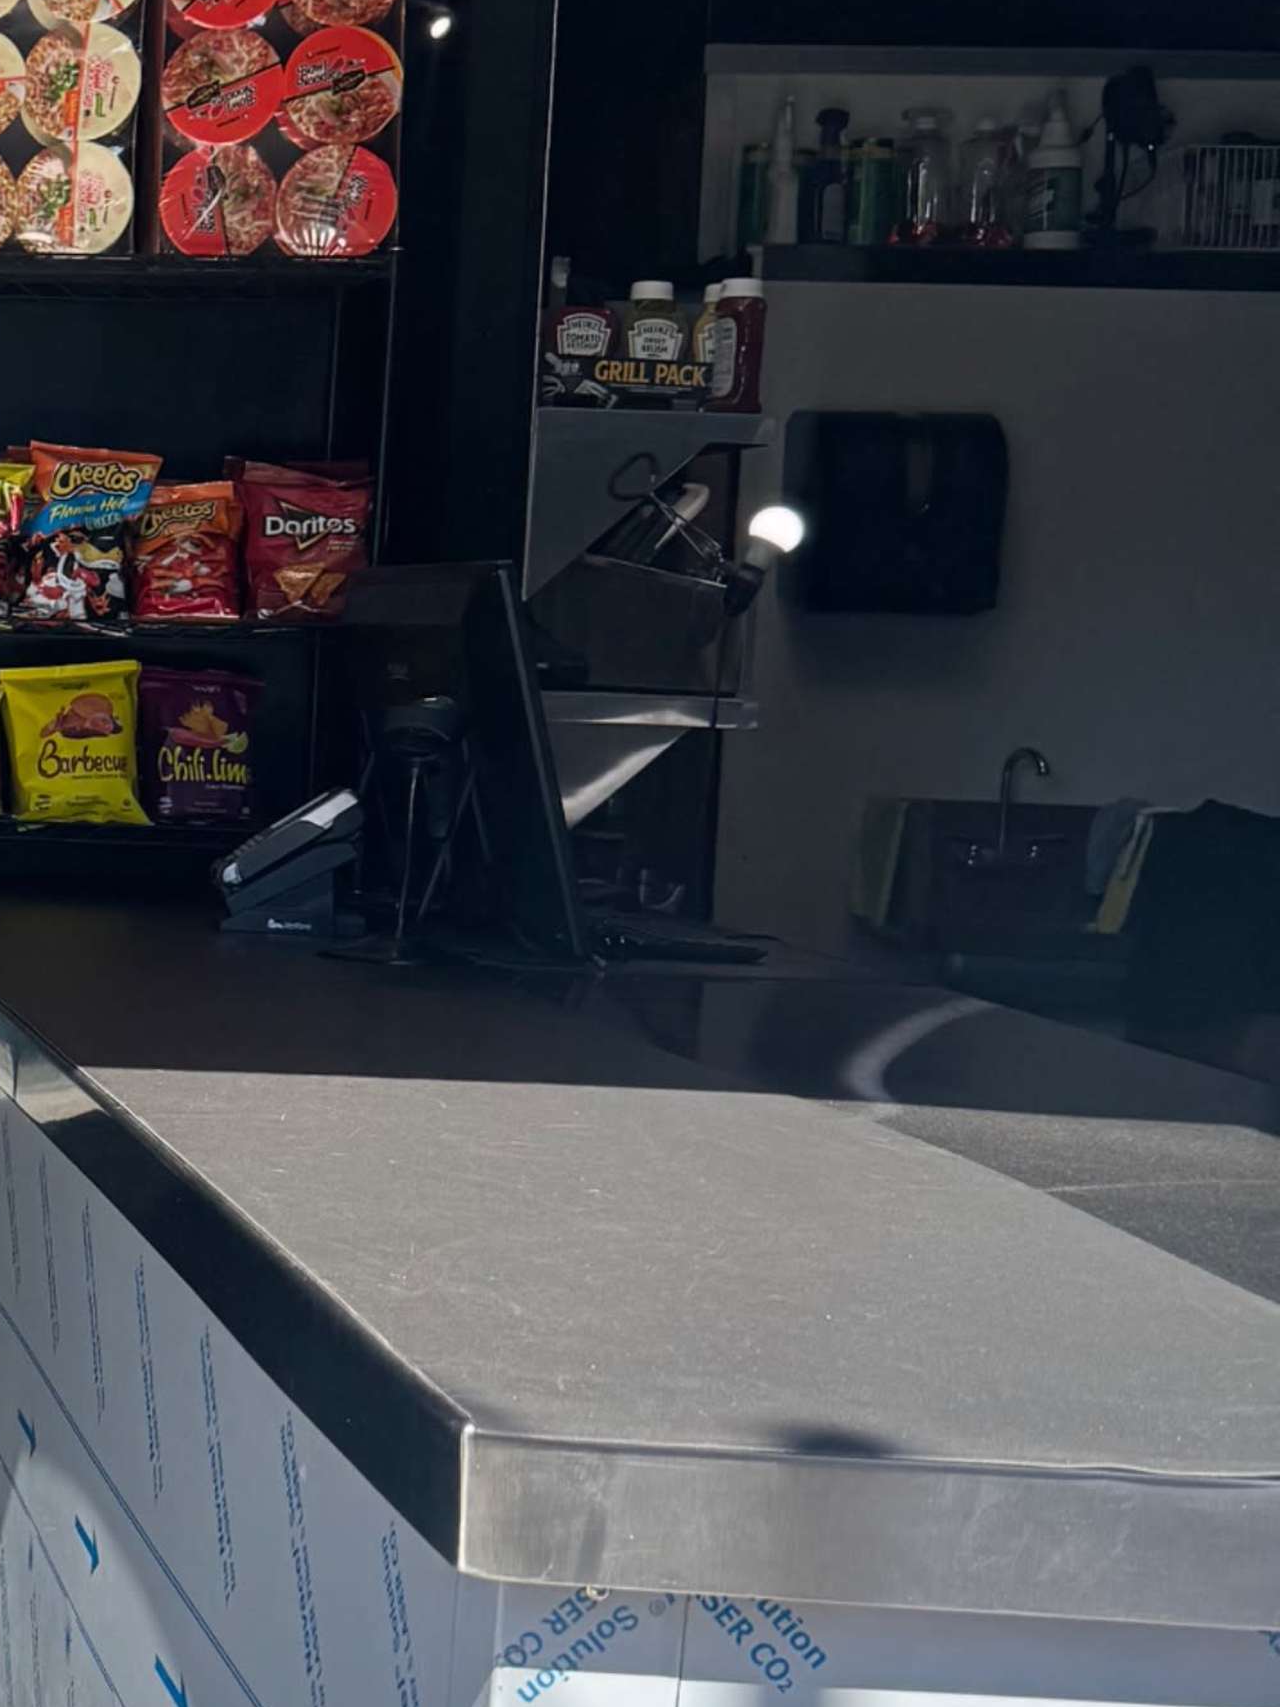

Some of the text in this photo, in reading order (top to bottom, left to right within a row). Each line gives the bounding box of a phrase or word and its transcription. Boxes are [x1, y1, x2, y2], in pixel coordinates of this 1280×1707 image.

[594, 359, 707, 388] GRILL PACK
[50, 460, 141, 500] Cheetos
[141, 499, 216, 540] Cheetos
[264, 513, 356, 537] Doritos
[37, 738, 129, 779] Barbecue
[517, 1605, 640, 1703] Solution
